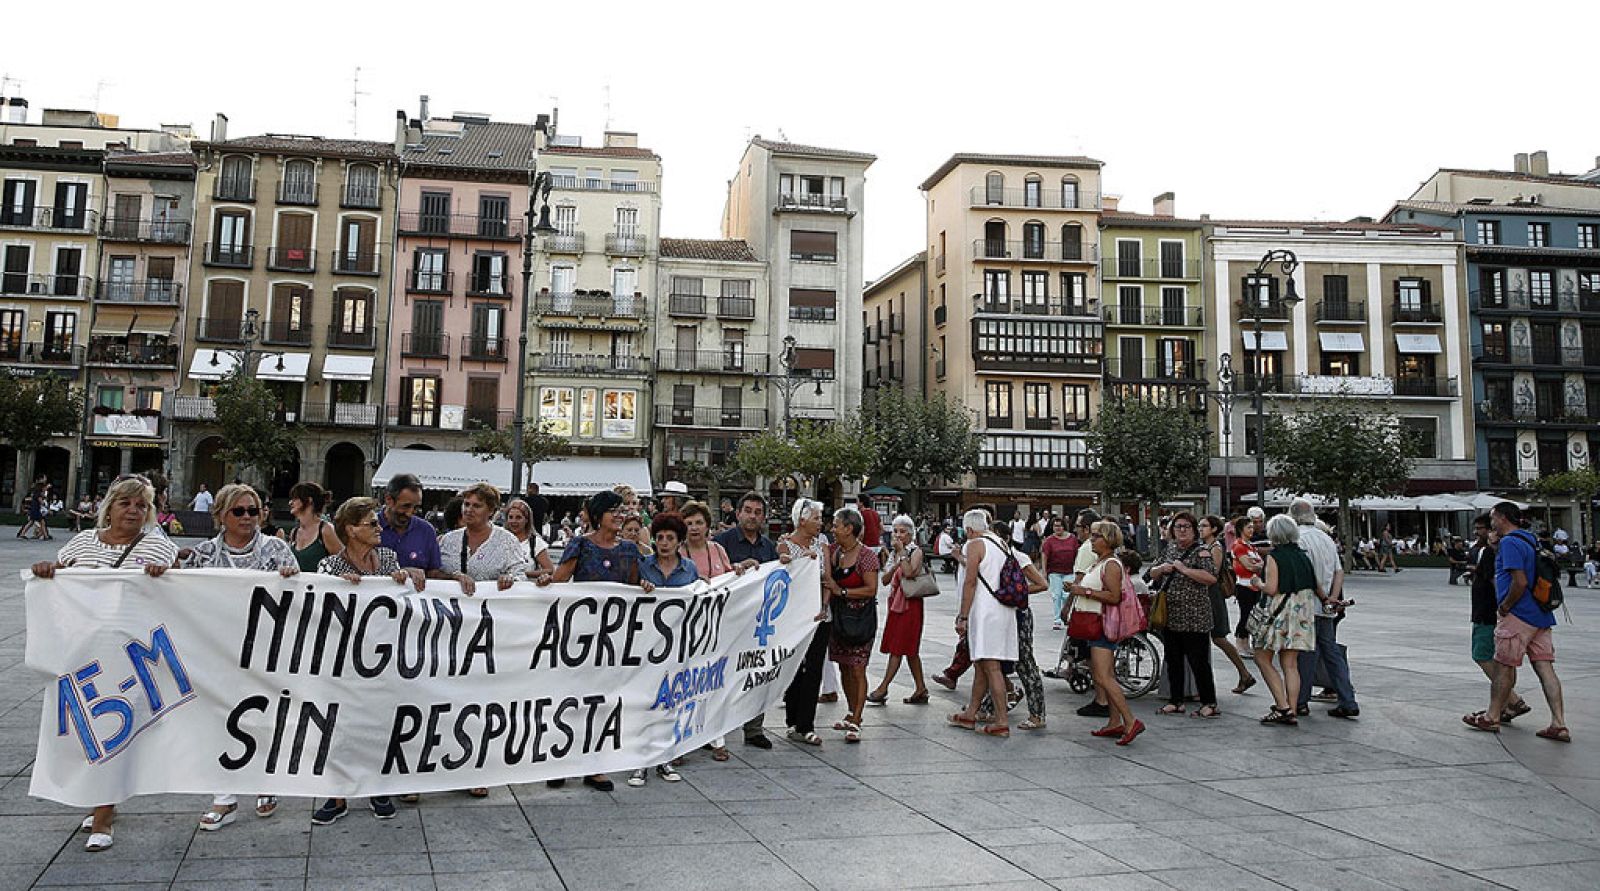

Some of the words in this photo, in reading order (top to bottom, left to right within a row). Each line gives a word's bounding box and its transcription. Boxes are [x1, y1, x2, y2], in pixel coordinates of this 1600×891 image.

[240, 585, 496, 679] NINGUNA
[57, 623, 195, 764] 15-M
[218, 689, 340, 775] SIN
[381, 695, 623, 775] RESPUESTA
